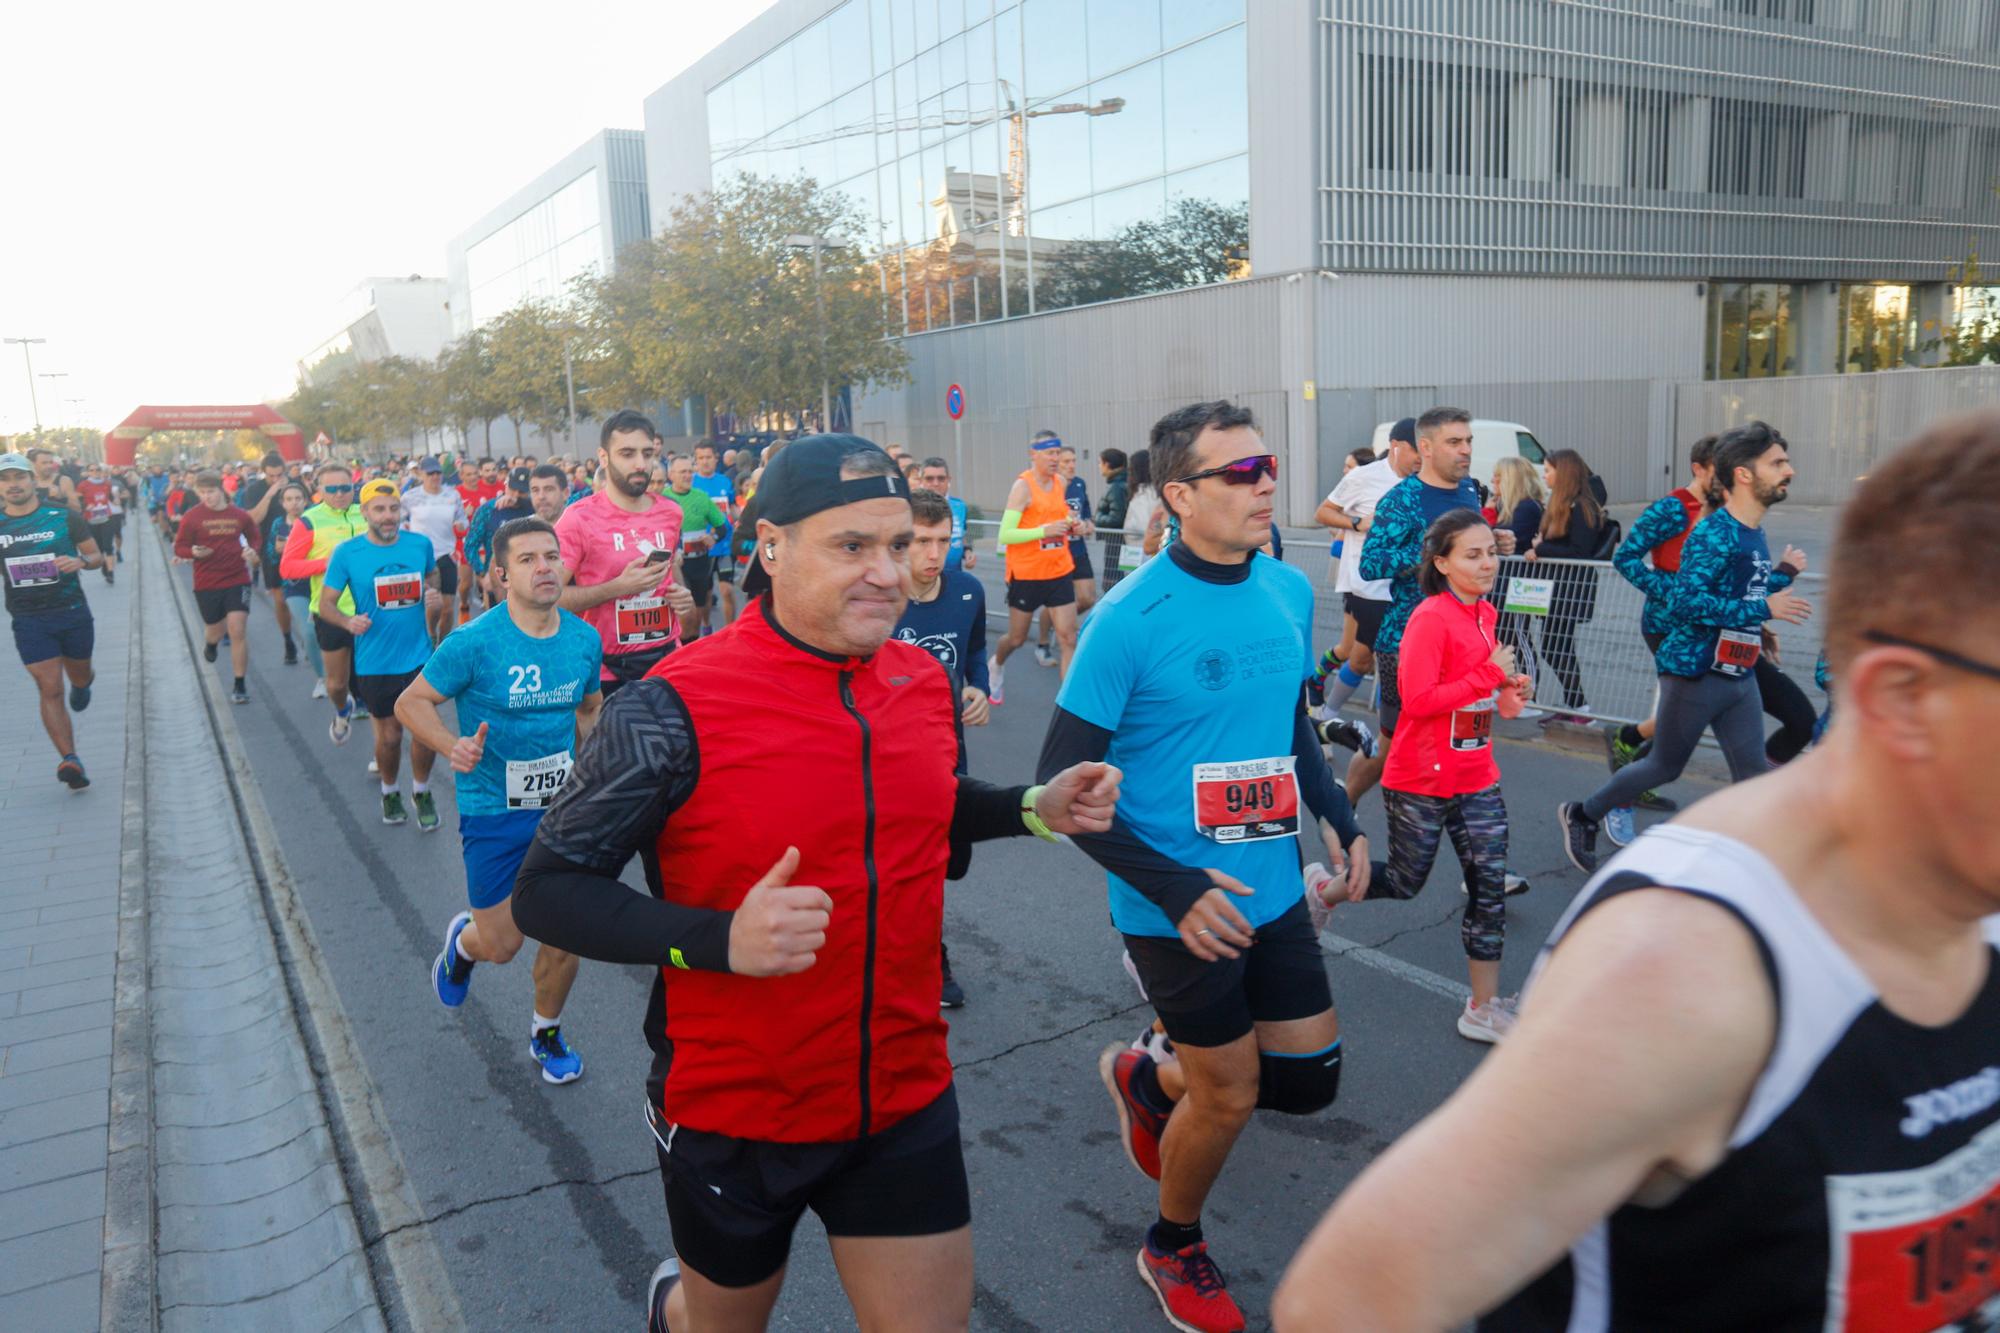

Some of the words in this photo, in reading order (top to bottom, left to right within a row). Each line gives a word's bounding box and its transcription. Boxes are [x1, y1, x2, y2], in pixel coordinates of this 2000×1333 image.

[633, 609, 661, 626] 1170
[508, 664, 542, 694] 23
[1242, 668, 1256, 680] DE
[508, 699, 536, 709] CIUTAT
[537, 697, 547, 705] DE
[523, 769, 566, 792] 2752
[1226, 780, 1274, 813] 948
